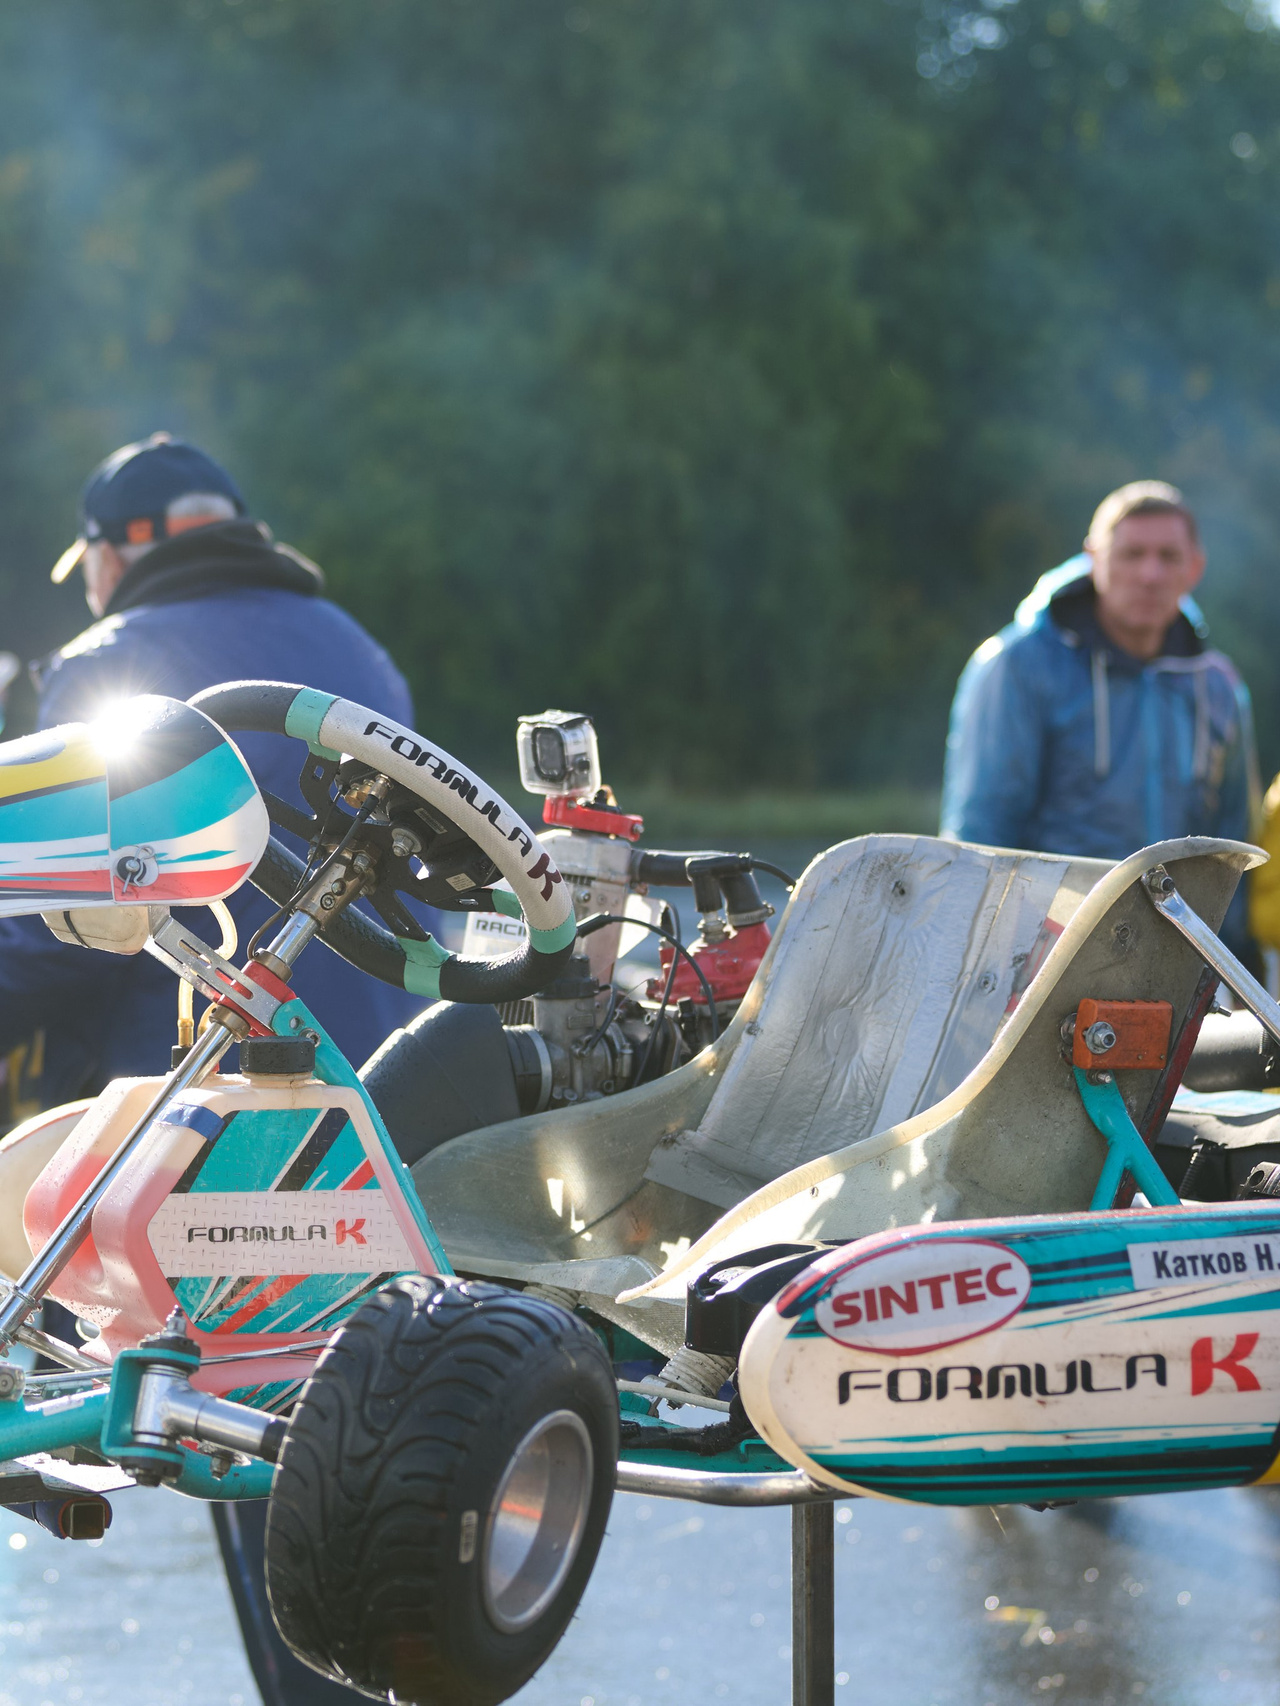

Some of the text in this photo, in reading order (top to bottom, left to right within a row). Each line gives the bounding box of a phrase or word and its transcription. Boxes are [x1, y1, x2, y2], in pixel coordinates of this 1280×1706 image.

[363, 721, 562, 901] FORMULA K
[476, 919, 526, 937] RACI
[187, 1218, 368, 1245] FORMULA K
[1153, 1250, 1248, 1279] Катков
[832, 1262, 1017, 1329] SINTEC
[838, 1332, 1261, 1405] FORMULA K
